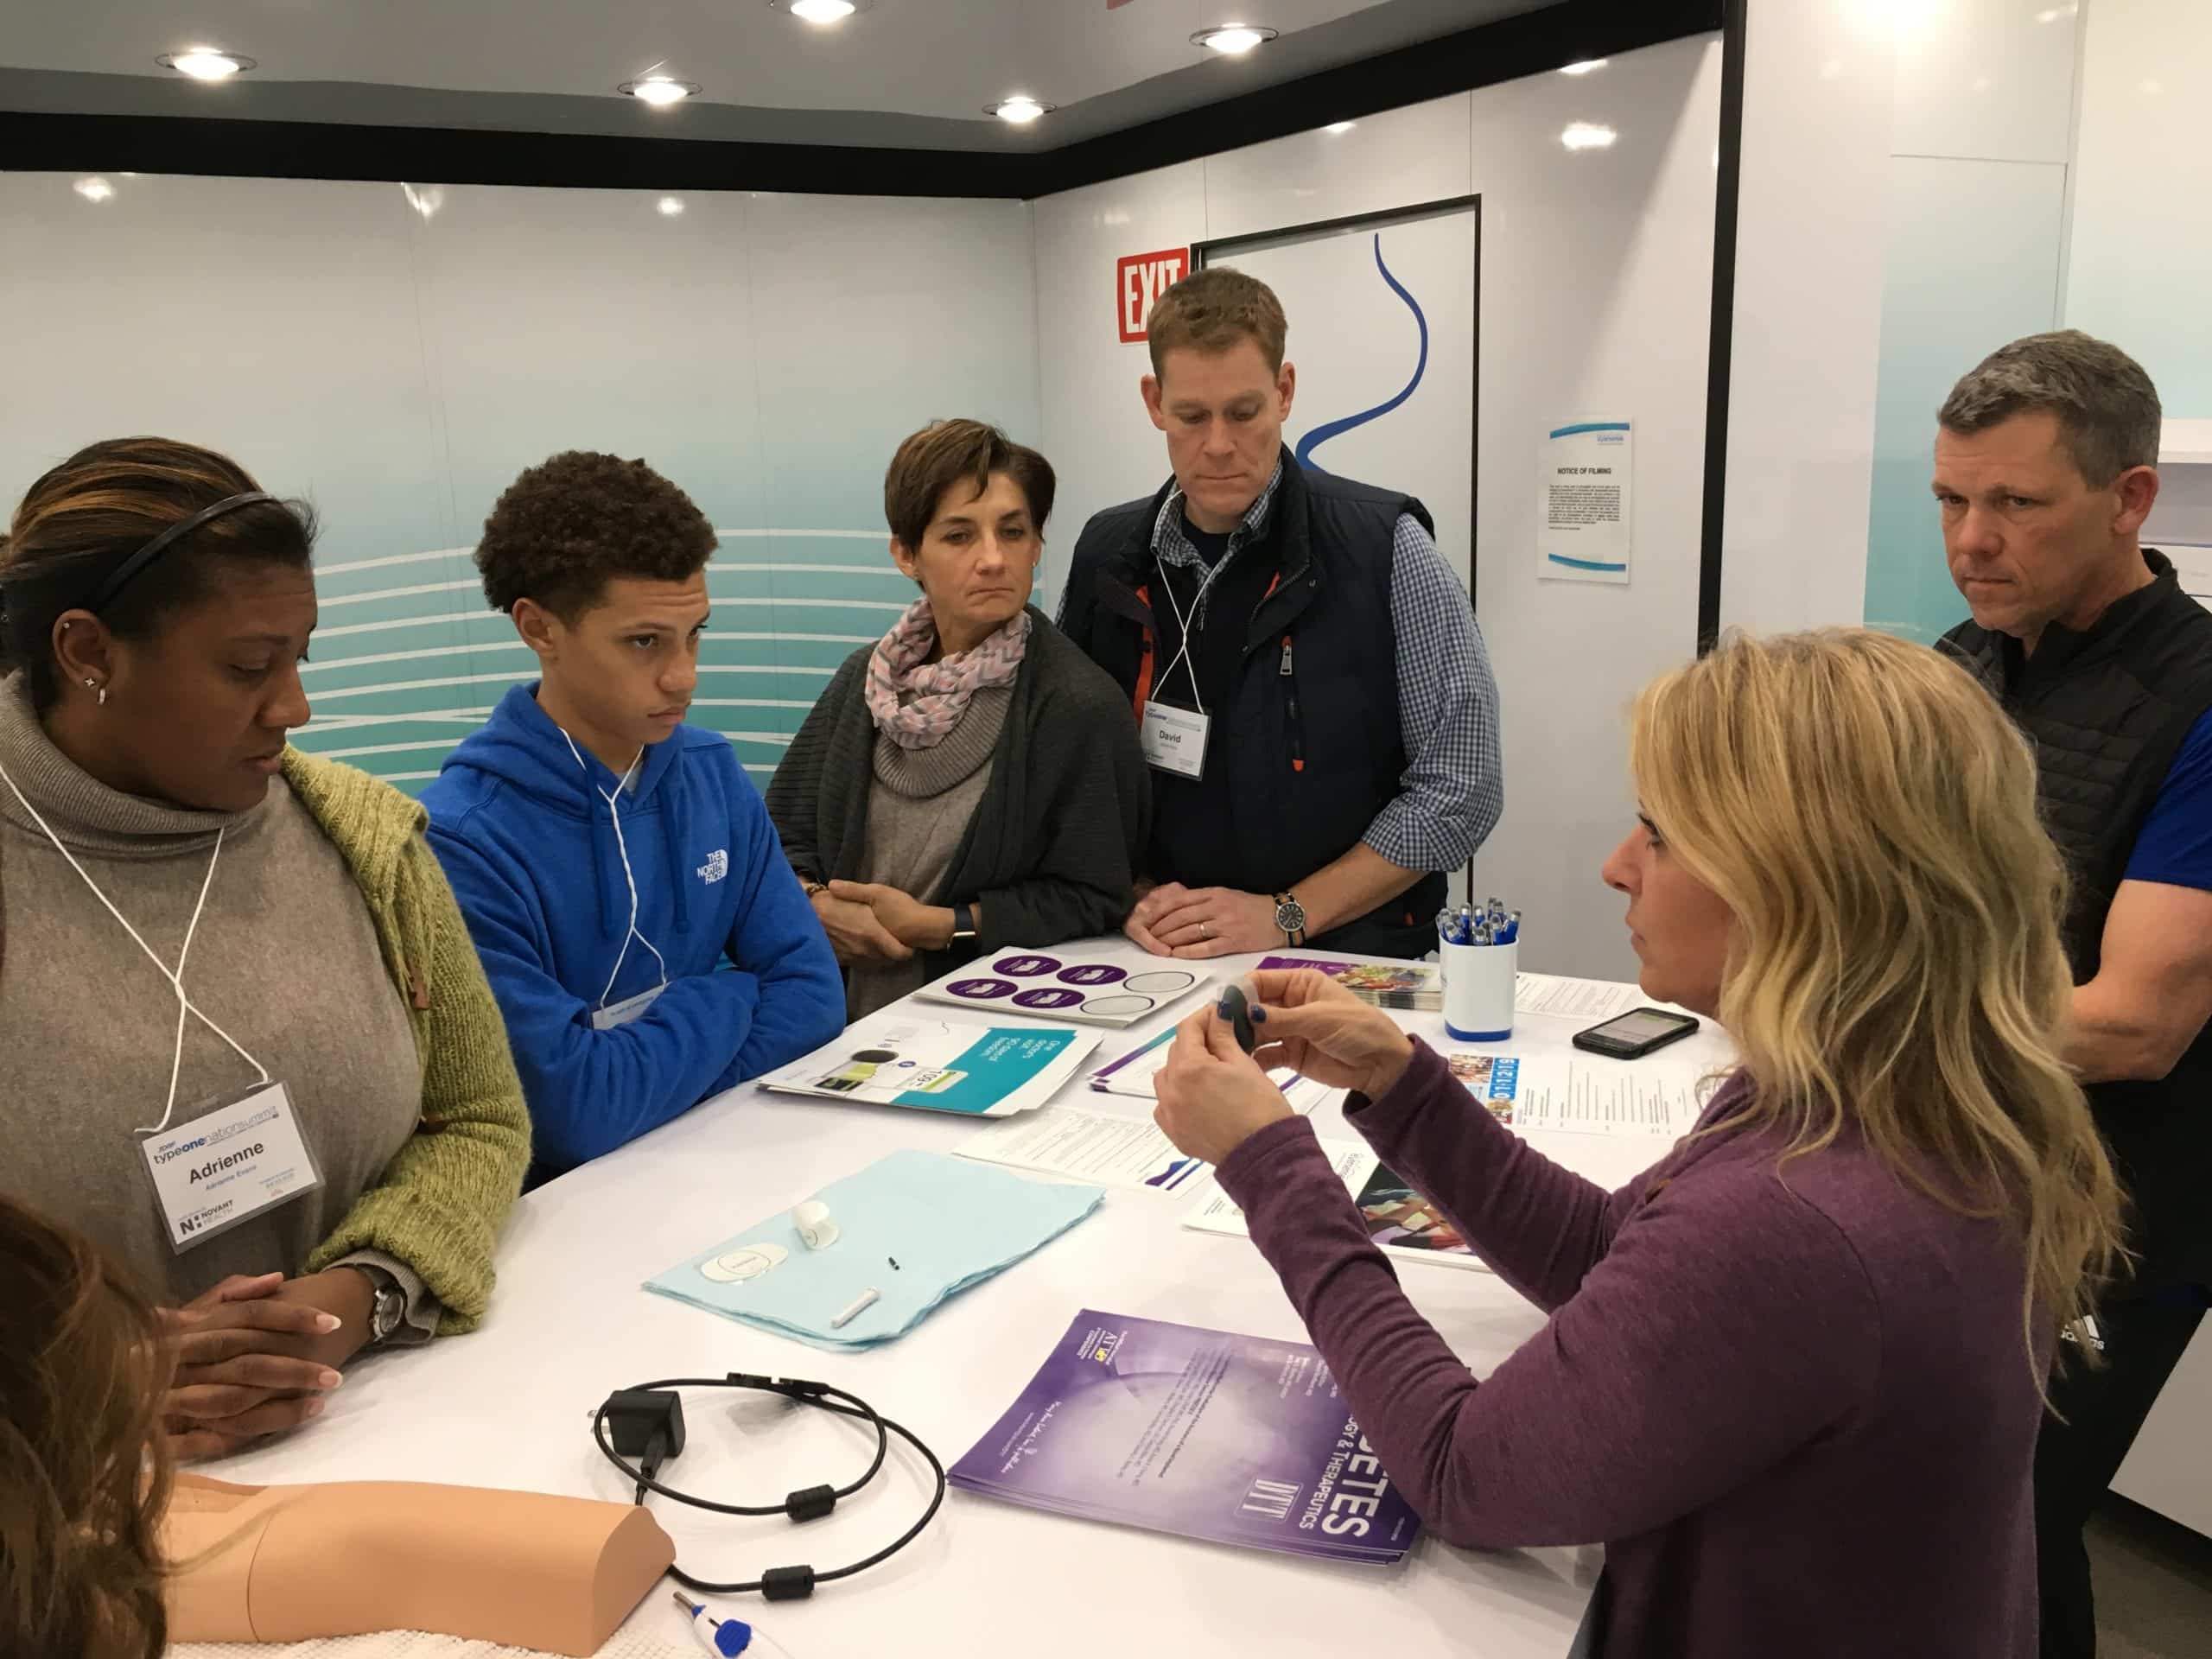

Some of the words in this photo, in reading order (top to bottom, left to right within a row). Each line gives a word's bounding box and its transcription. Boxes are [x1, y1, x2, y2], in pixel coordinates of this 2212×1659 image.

[1159, 730, 1181, 743] David
[189, 1142, 264, 1185] Adrienne
[1337, 1440, 1354, 1449] &
[1242, 1478, 1300, 1519] DTT
[1300, 1452, 1351, 1529] THERAPEUTICS
